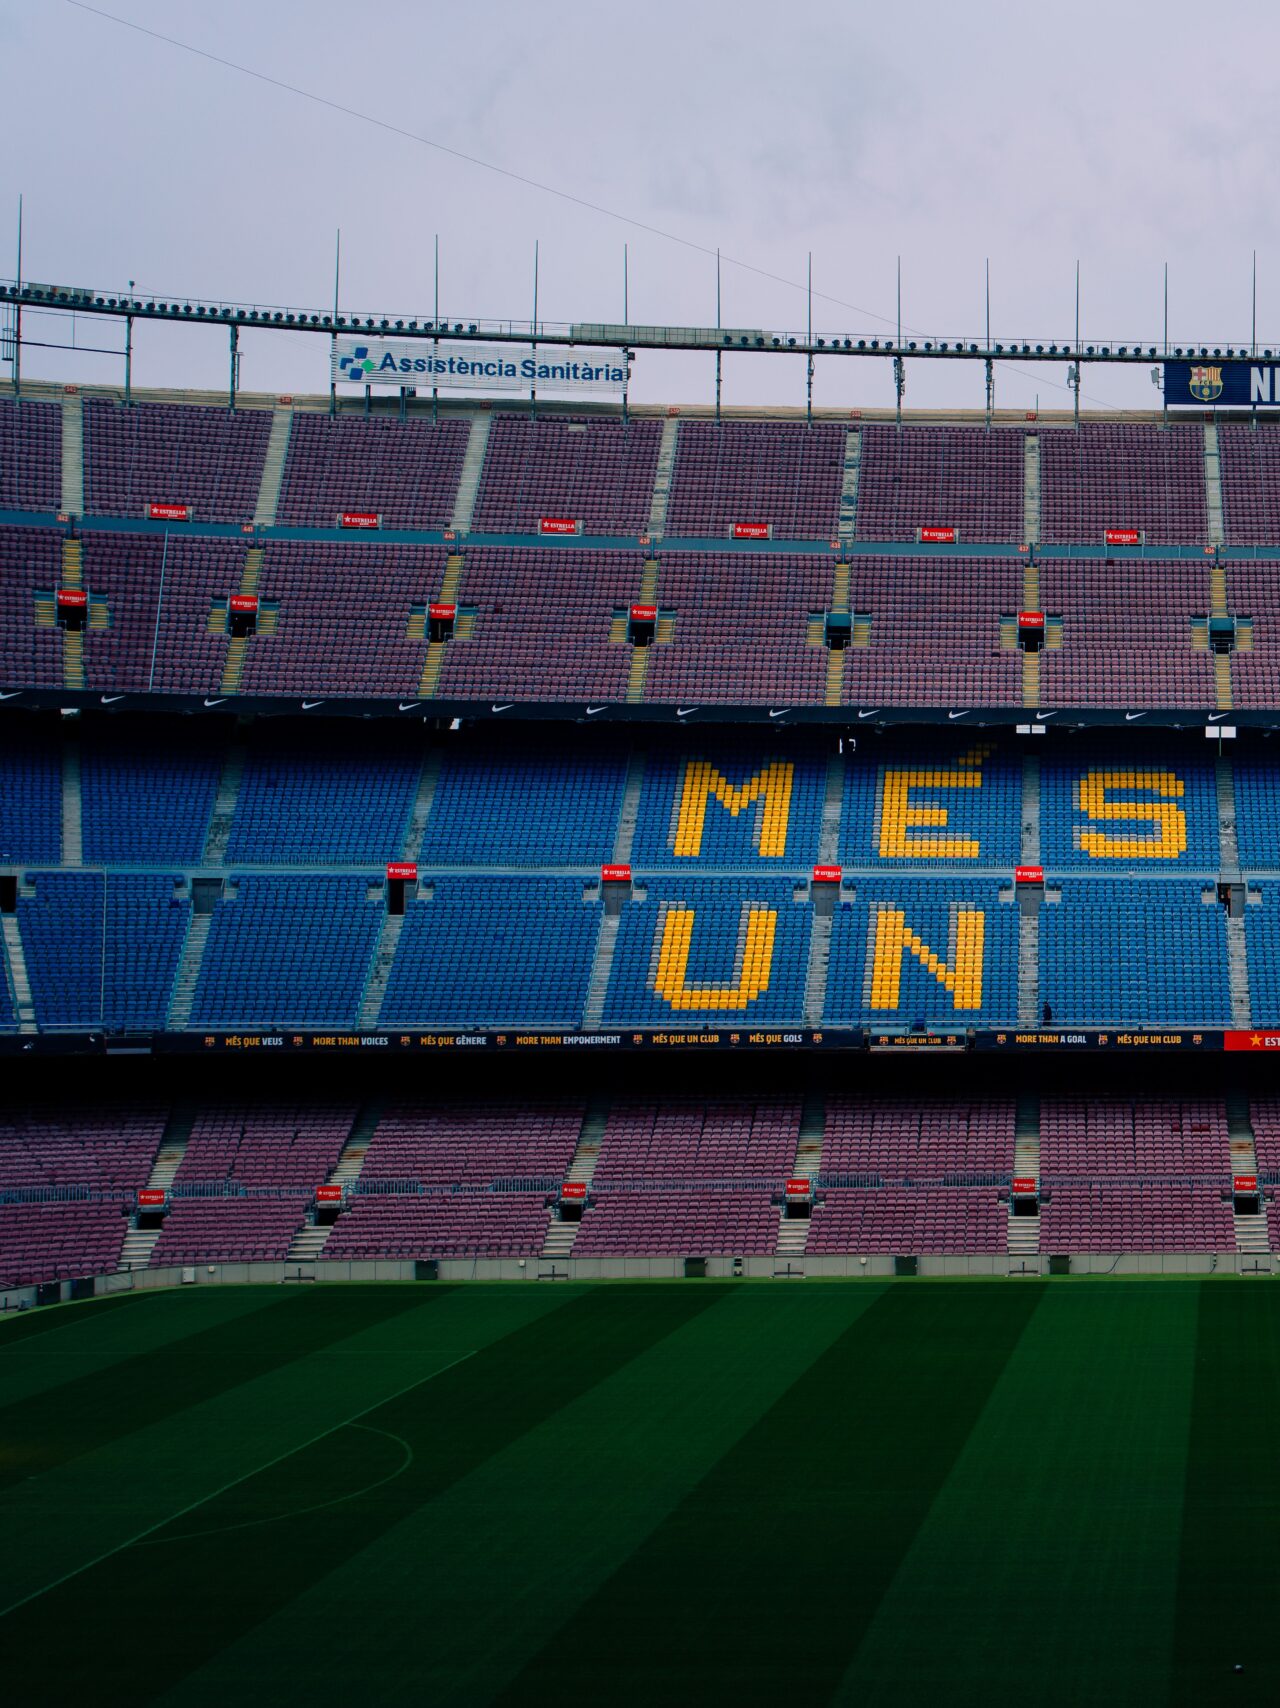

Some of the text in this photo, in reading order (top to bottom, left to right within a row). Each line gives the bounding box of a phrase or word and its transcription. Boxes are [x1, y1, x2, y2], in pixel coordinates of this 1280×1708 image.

[379, 352, 624, 381] Assistència Sanitària
[671, 744, 1187, 859] MÉS
[653, 908, 985, 1011] UN
[226, 1036, 241, 1045] MÉS
[244, 1038, 259, 1047] QUE
[313, 1037, 388, 1045] MORE THAN VOICES
[421, 1035, 486, 1046] MÉS QUE GÈNERE
[563, 1036, 620, 1044] EMPOWERMENT
[653, 1034, 719, 1045] MÉS QUE UN CLUB
[750, 1033, 764, 1042] MÉS
[766, 1035, 782, 1044] QUE
[1016, 1035, 1086, 1043] MORE THAN A GOAL
[1117, 1034, 1132, 1044] MÉS
[1133, 1036, 1148, 1045] QUE
